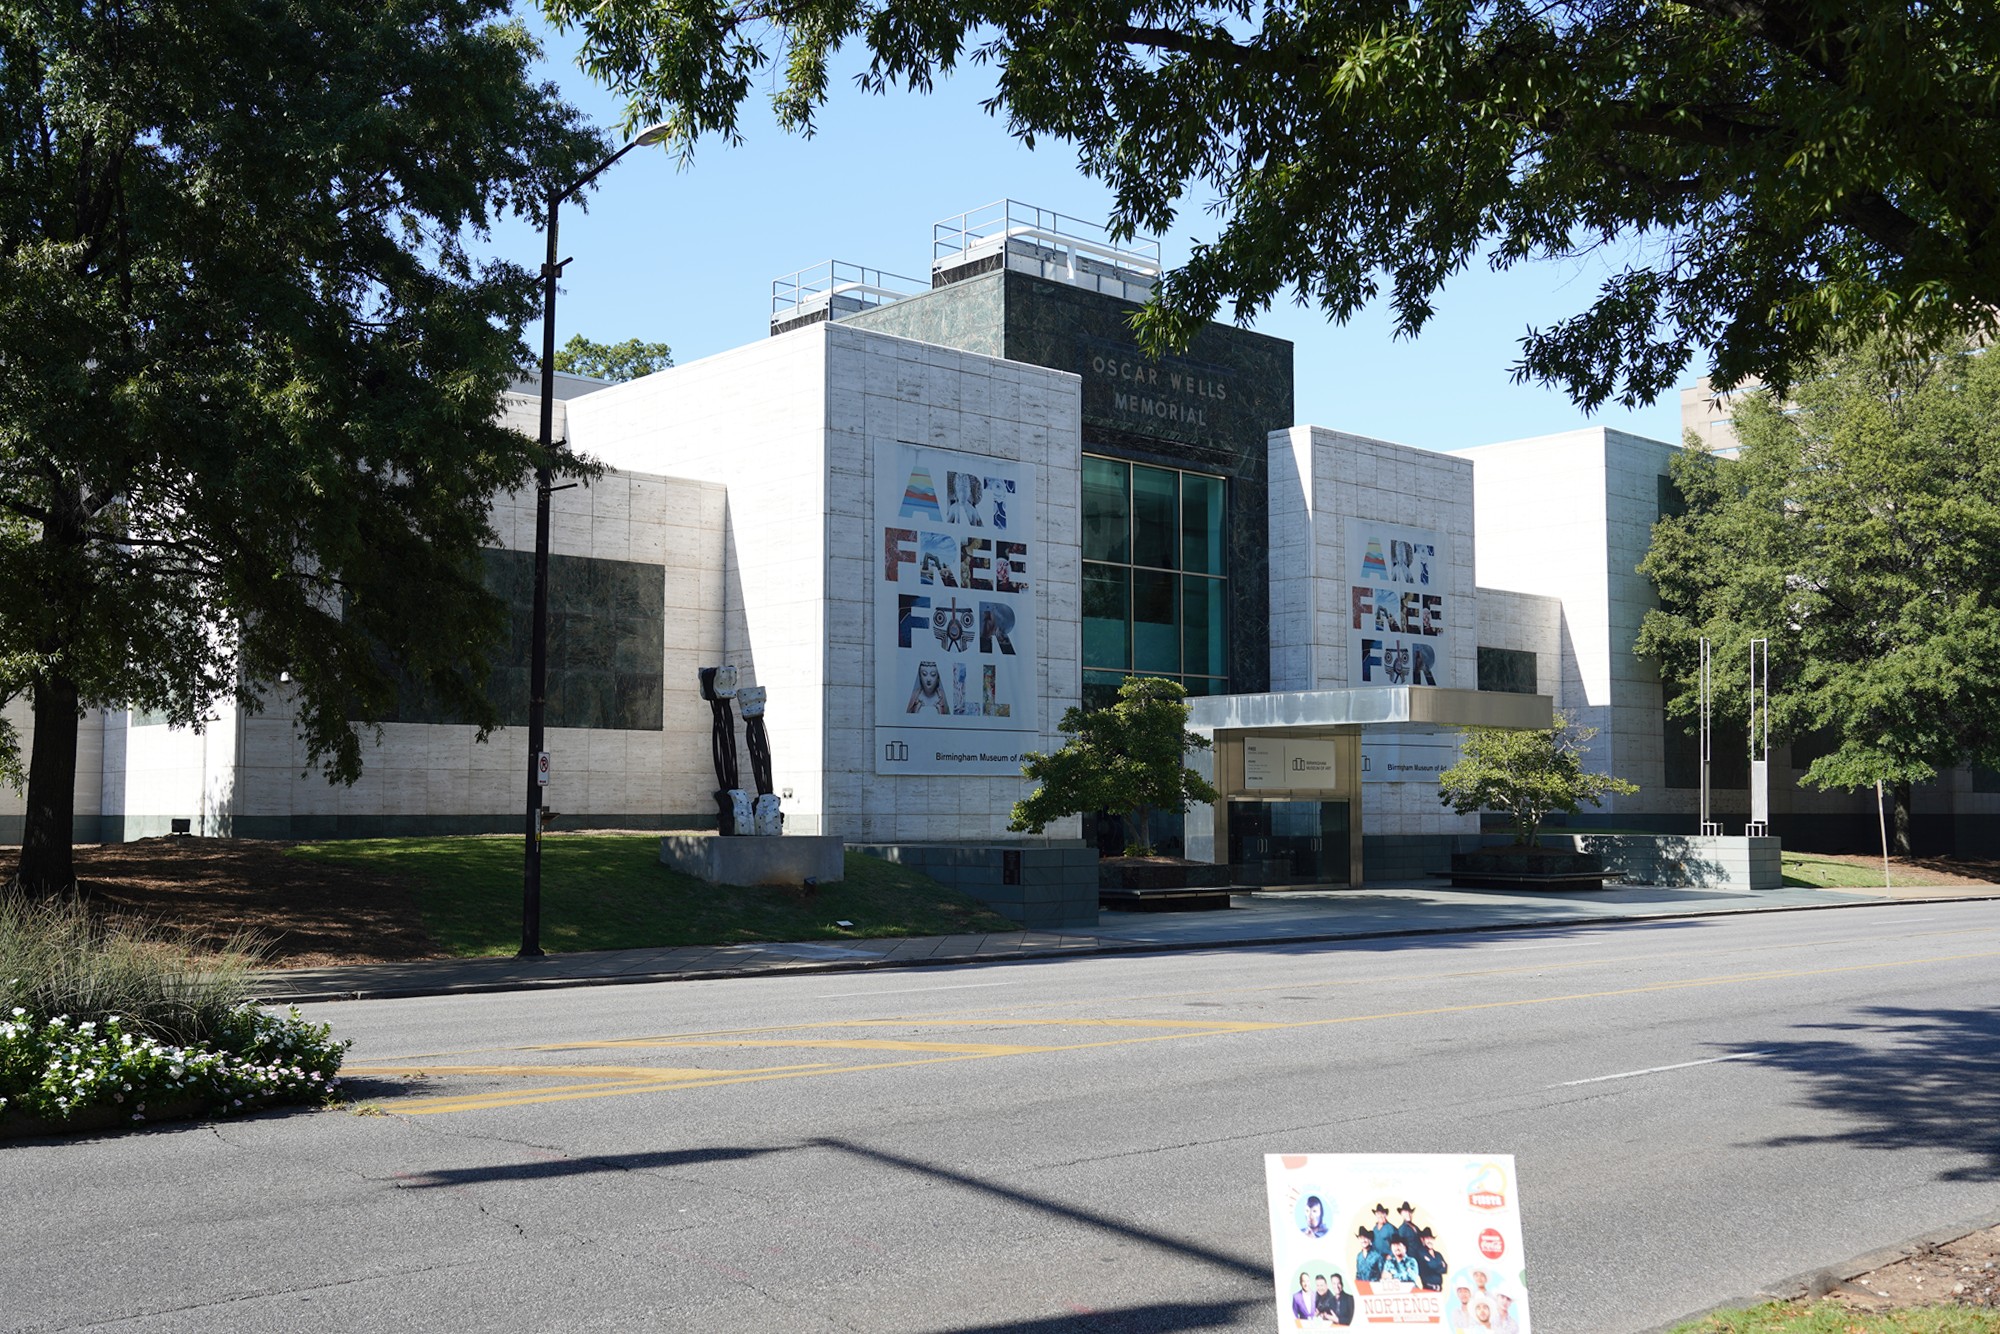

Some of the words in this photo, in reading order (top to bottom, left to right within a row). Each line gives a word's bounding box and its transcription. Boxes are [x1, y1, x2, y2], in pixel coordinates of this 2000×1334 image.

[1092, 356, 1158, 385] OSCAR
[1170, 373, 1227, 400] WELLS
[1115, 392, 1207, 426] MEMORIAL
[898, 466, 1016, 530] ART
[884, 527, 1029, 594] FREE
[1361, 536, 1435, 585] ART
[898, 593, 1016, 655] FOR
[1352, 586, 1443, 636] FREE
[1361, 639, 1437, 686] FOR
[906, 661, 1010, 717] ALL
[935, 752, 978, 762] Birmingham
[979, 753, 1008, 762] Museum
[1009, 753, 1018, 762] of
[1387, 763, 1413, 772] Birmingham
[1414, 764, 1433, 772] Museum
